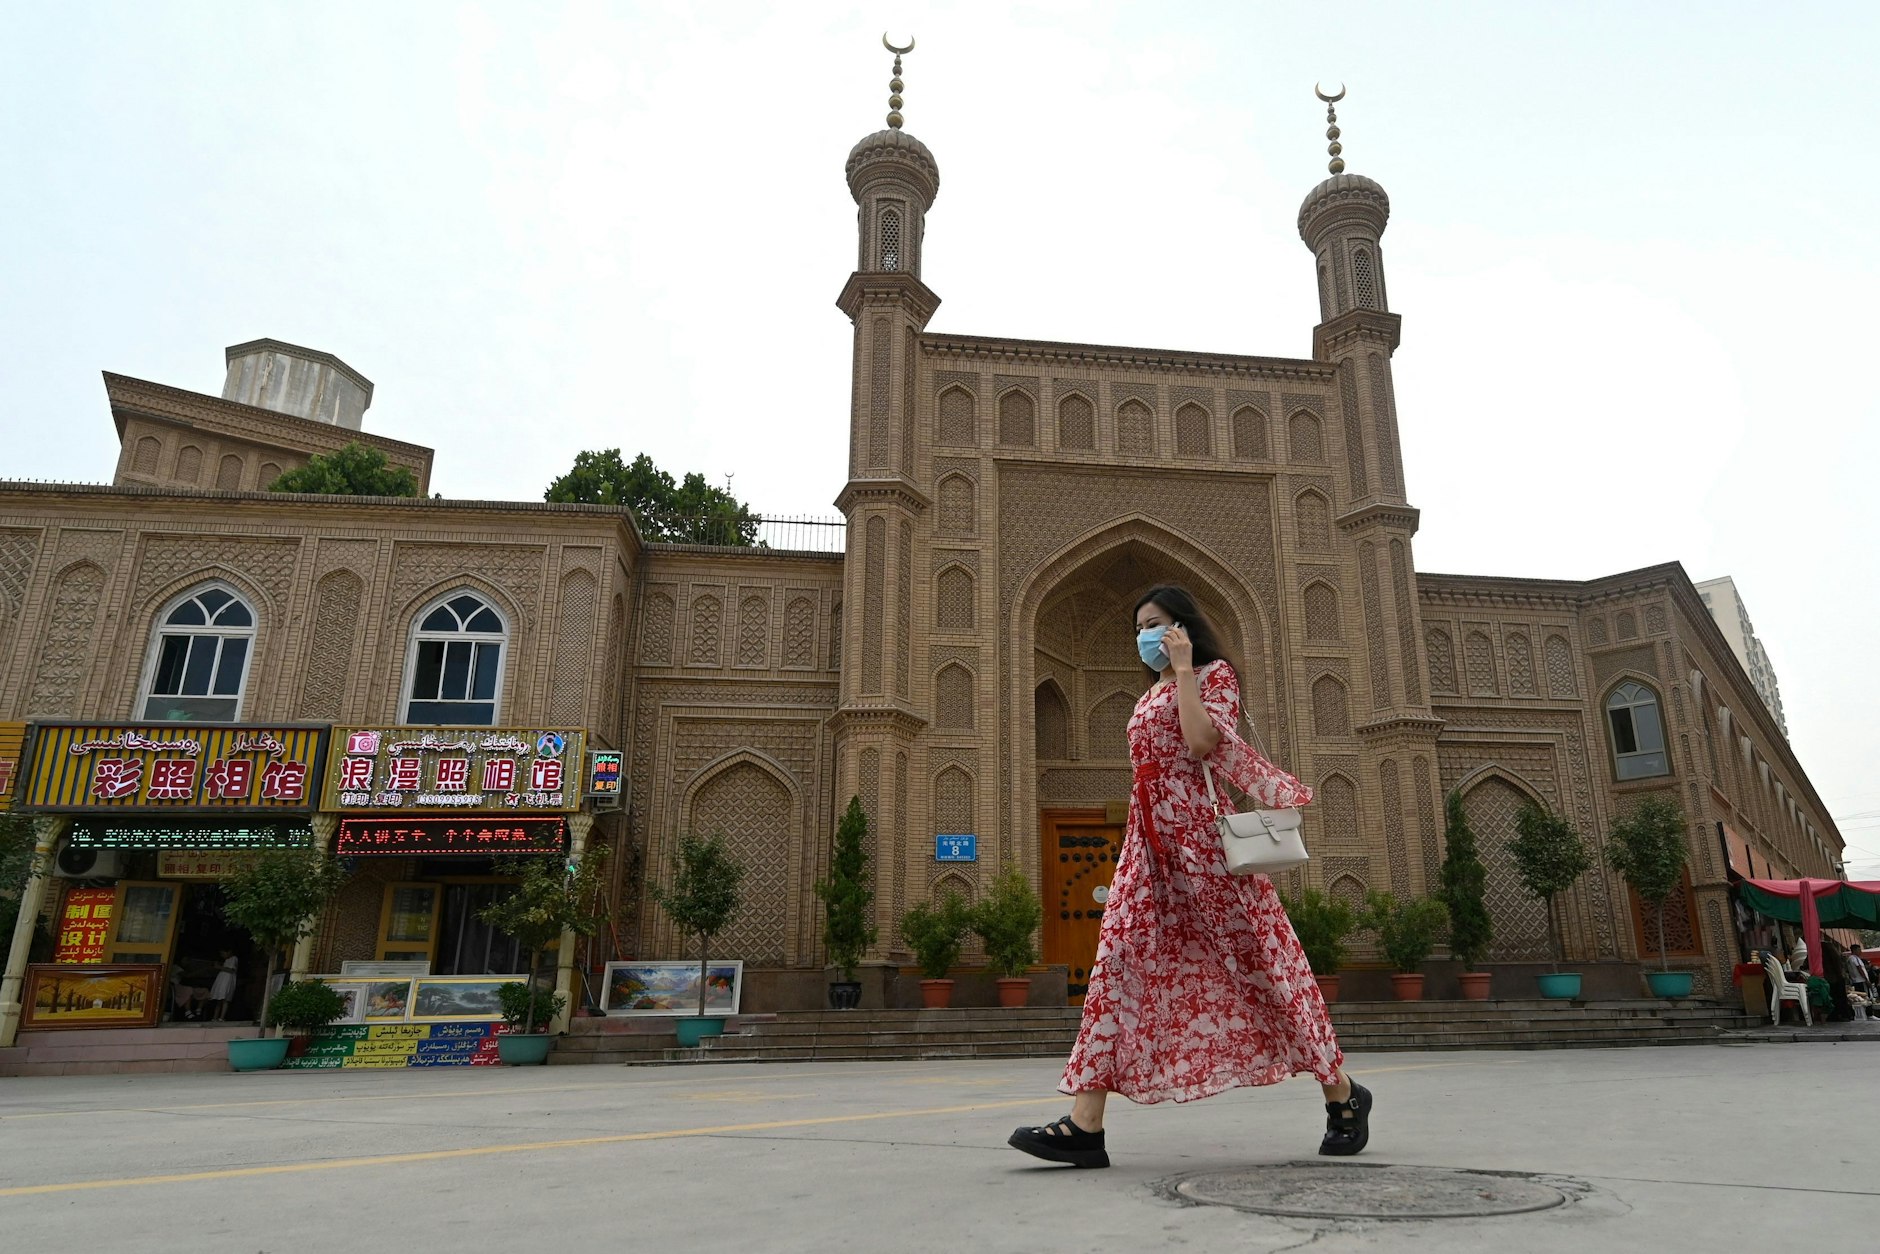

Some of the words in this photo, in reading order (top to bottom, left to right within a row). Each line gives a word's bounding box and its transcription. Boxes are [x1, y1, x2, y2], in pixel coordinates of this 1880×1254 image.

[91, 758, 307, 800] 彩照相馆
[338, 757, 564, 791] 浪漫照相馆
[594, 780, 617, 790] 复印
[341, 792, 369, 806] 打印
[373, 792, 402, 806] 复印
[522, 792, 563, 805] 飞机票
[951, 845, 959, 856] 8
[65, 904, 113, 919] 制图
[60, 930, 107, 946] 设计
